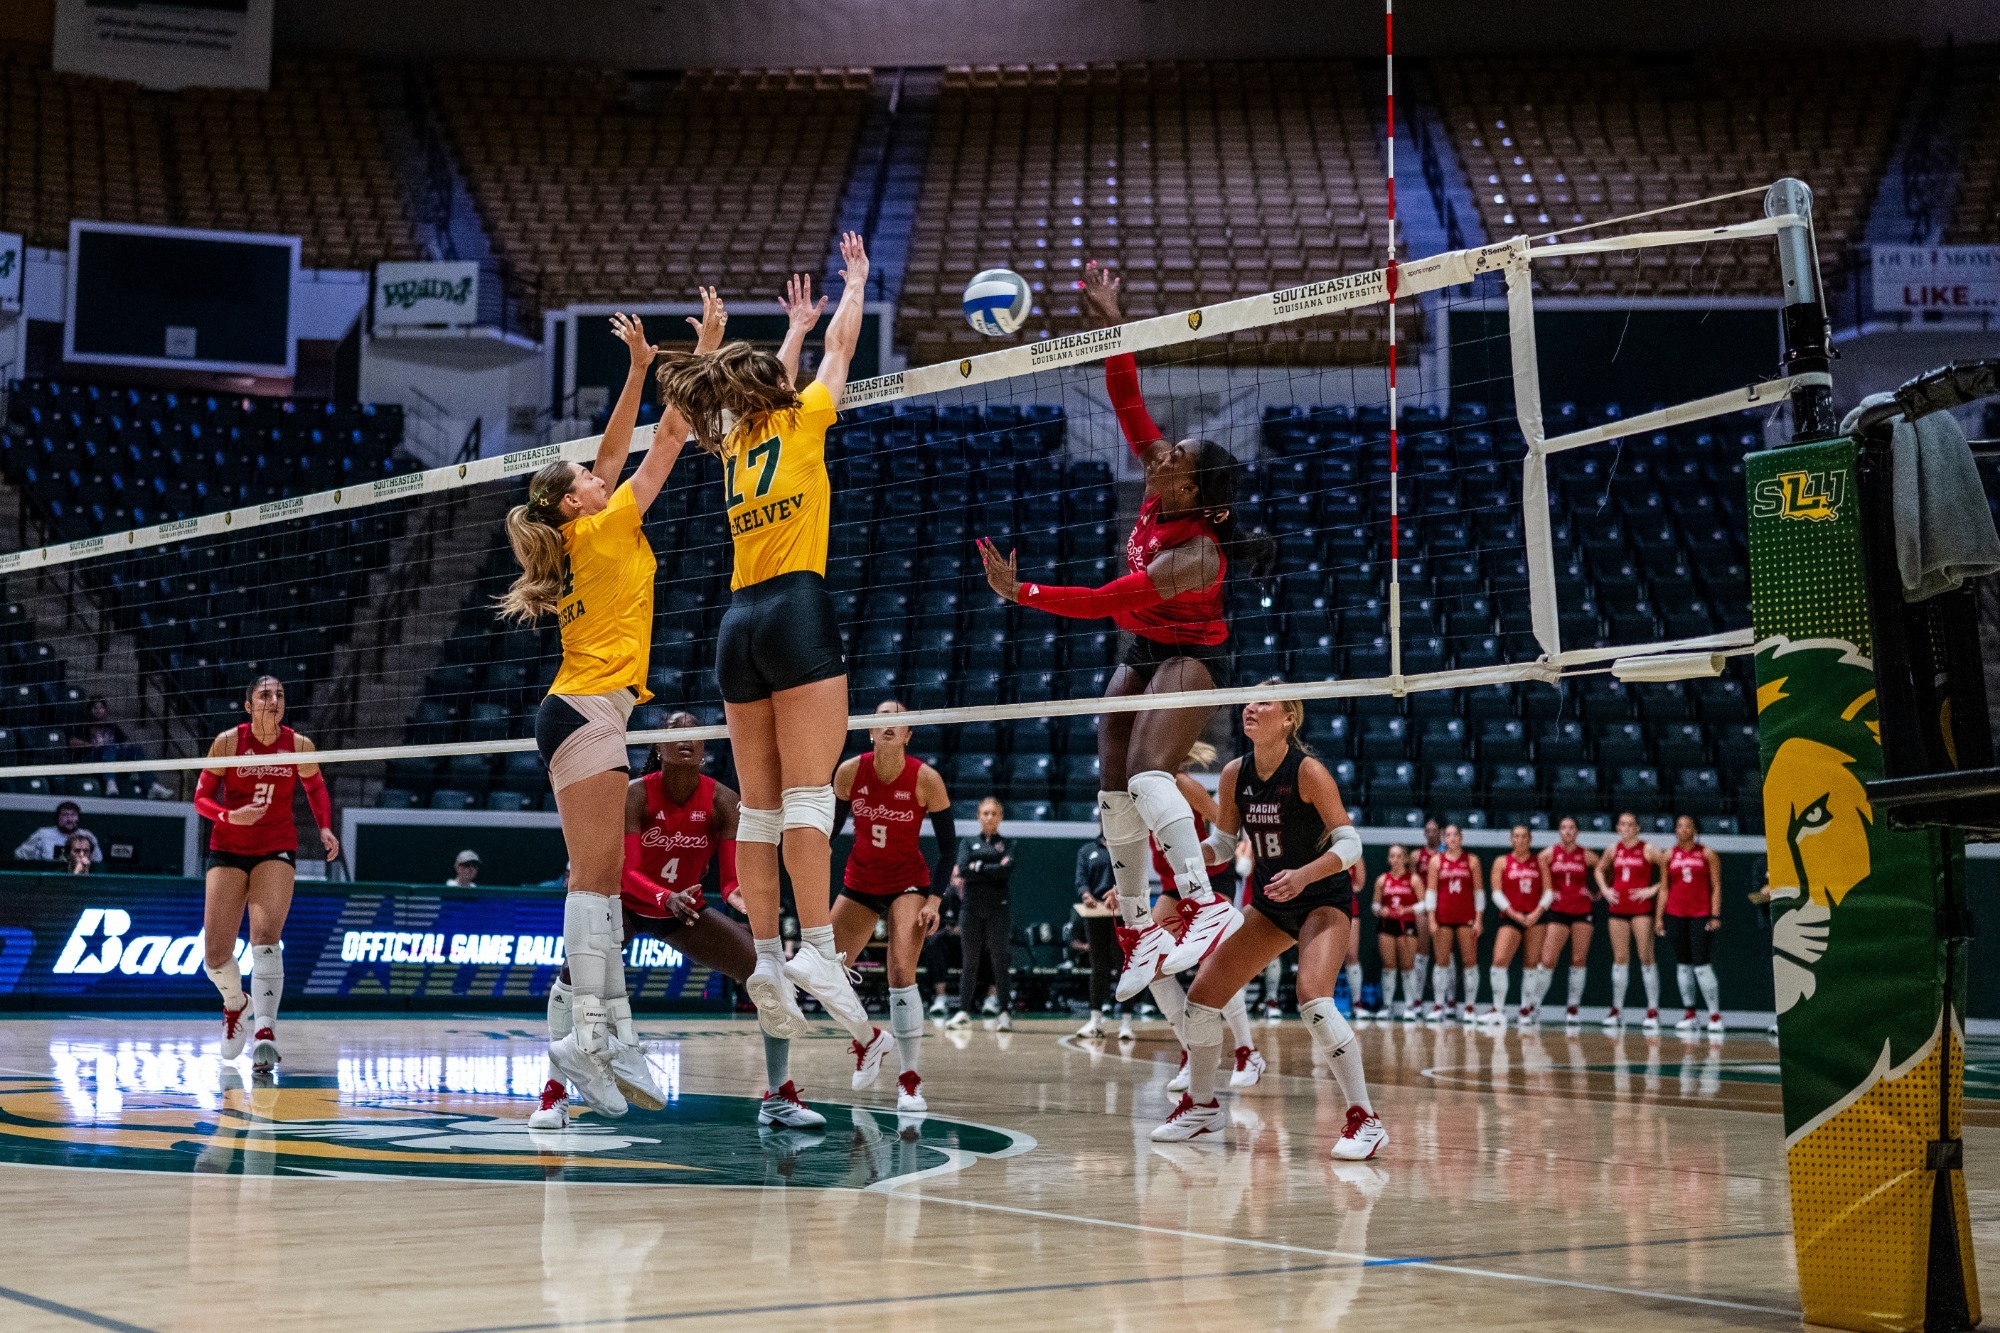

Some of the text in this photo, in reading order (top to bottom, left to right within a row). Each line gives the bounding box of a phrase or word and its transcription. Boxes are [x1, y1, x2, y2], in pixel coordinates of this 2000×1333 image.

[1487, 245, 1513, 256] Senoh
[1273, 271, 1381, 304] SOUTHEASTERN
[1273, 285, 1383, 315] LOUISIANA UNIVERSITY
[1031, 326, 1122, 355] SOUTHEASTERN
[1032, 340, 1122, 365] LOUISIANA UNIVERSITY
[843, 373, 904, 394] THEASTERN
[864, 386, 905, 400] UNIVERSITY
[504, 445, 560, 464] SOUTHEASTERN
[374, 473, 423, 490] SOUTHEASTERN
[726, 435, 782, 511] 17
[1753, 469, 1847, 522] SLU
[252, 783, 275, 804] 21
[852, 798, 914, 821] Cajuns
[1246, 814, 1280, 824] CAJUNS
[641, 826, 708, 851] Cajuns
[872, 824, 887, 848] 9
[1254, 831, 1282, 858] 18
[661, 858, 680, 883] 4
[341, 931, 446, 963] OFFICIAL
[449, 933, 514, 964] GAME
[515, 936, 565, 965] BALL
